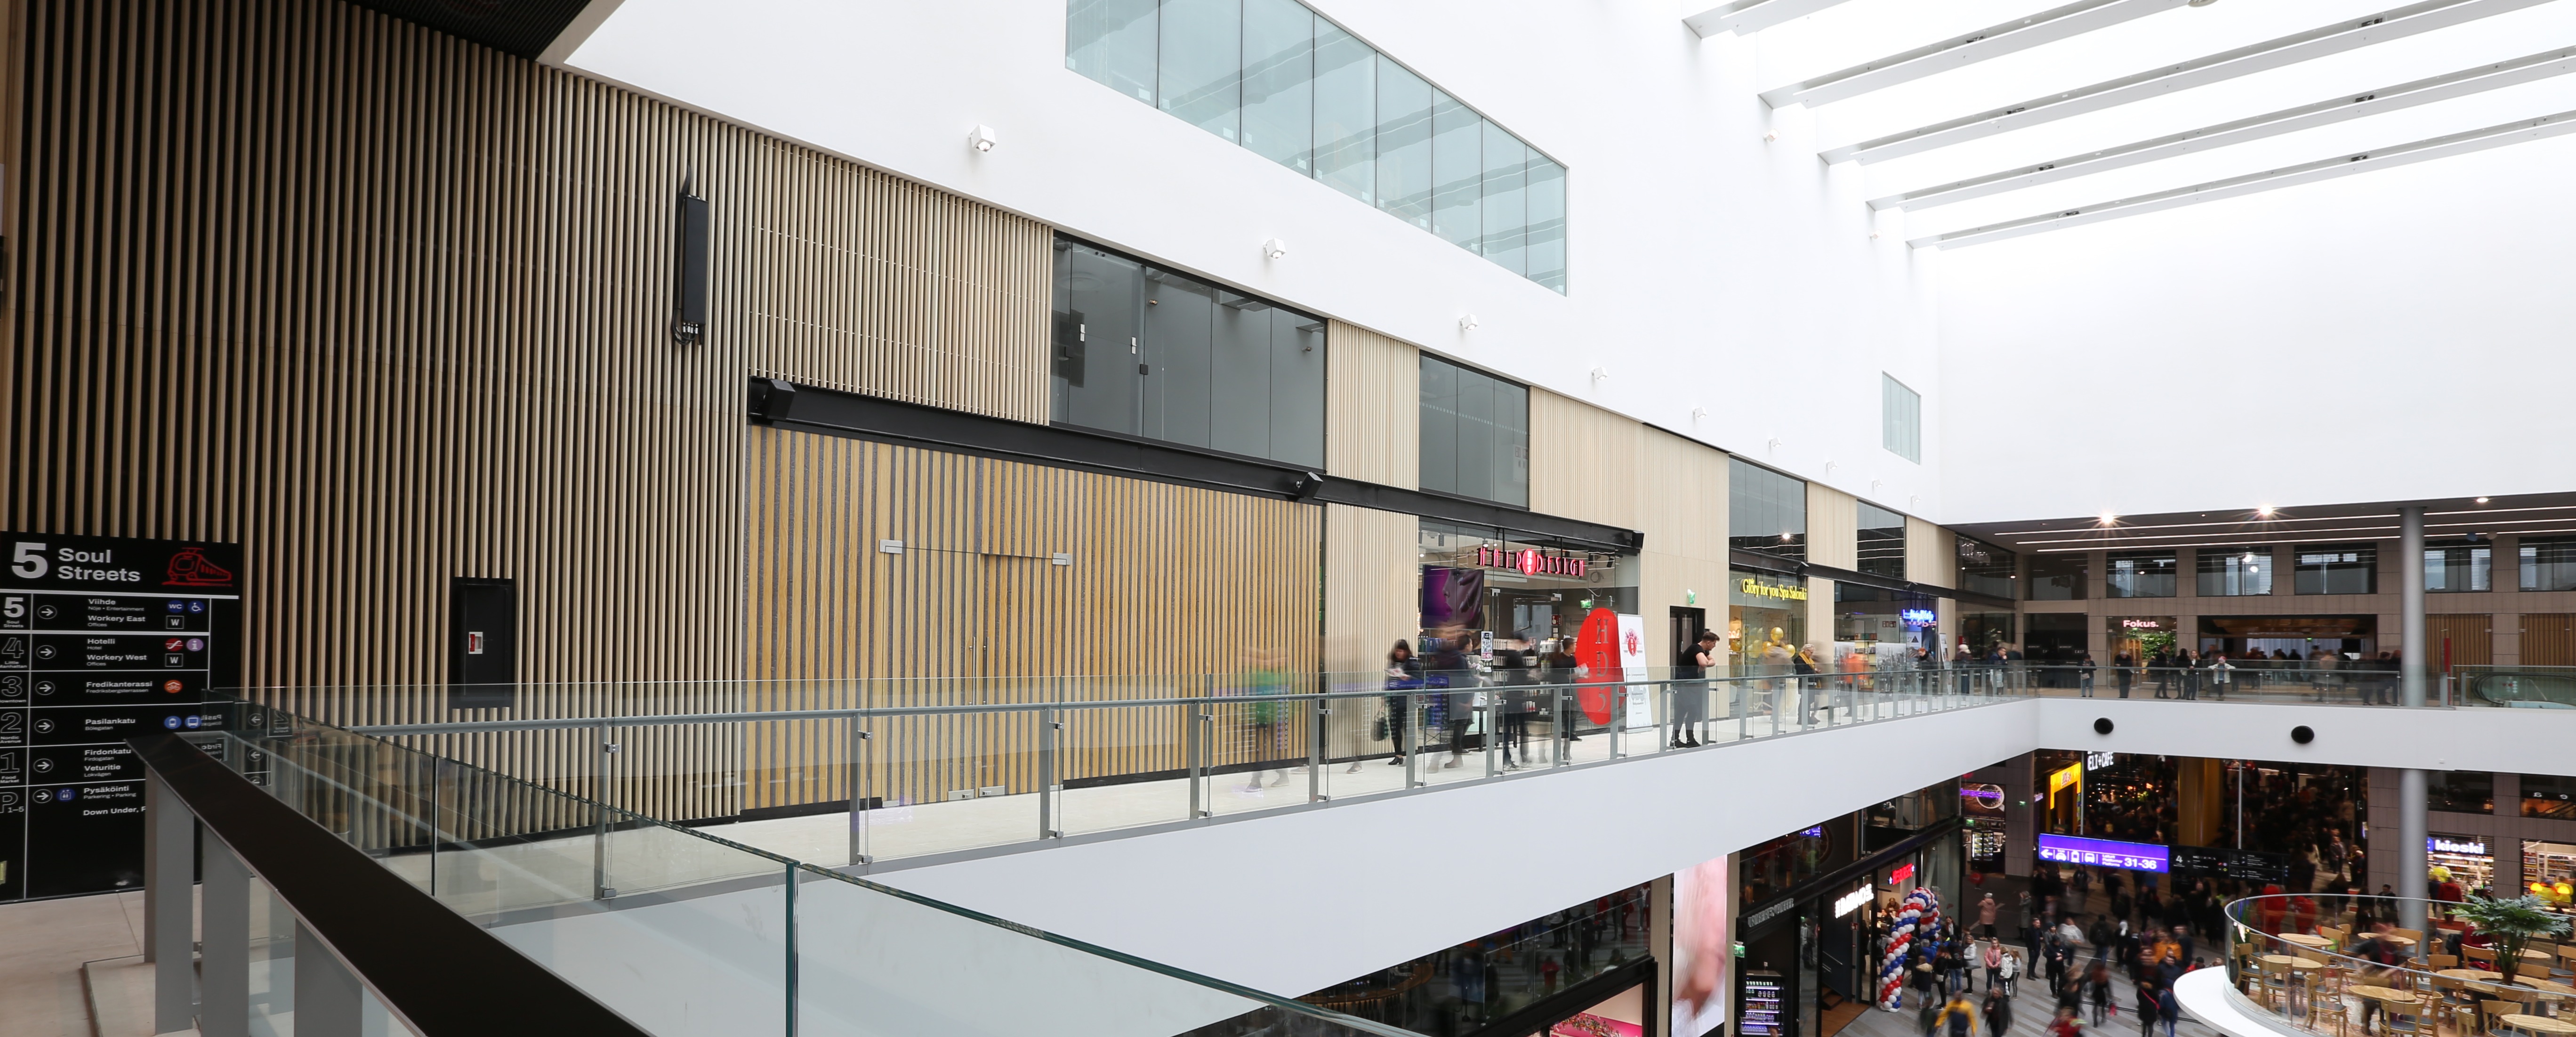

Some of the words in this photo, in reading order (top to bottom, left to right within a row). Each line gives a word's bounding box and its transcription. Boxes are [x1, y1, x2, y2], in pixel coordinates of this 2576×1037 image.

[12, 542, 48, 578] 5
[58, 548, 111, 563] Soul
[1479, 547, 1522, 570] HAIR
[1536, 554, 1585, 576] DESIGN
[57, 566, 140, 582] Streets
[1743, 578, 1760, 598] Glory
[1761, 581, 1769, 595] for
[1770, 587, 1779, 599] you
[1779, 584, 1789, 600] Spa
[1789, 585, 1807, 600] Salonki
[4, 597, 24, 618] 5
[2, 637, 24, 658] 4
[1, 676, 22, 697] 3
[0, 712, 22, 733] 2
[0, 752, 20, 773] 1
[84, 785, 129, 794] Pysäköinti
[0, 792, 18, 813] P
[2435, 839, 2484, 854] kioski
[2124, 858, 2157, 869] 31-36
